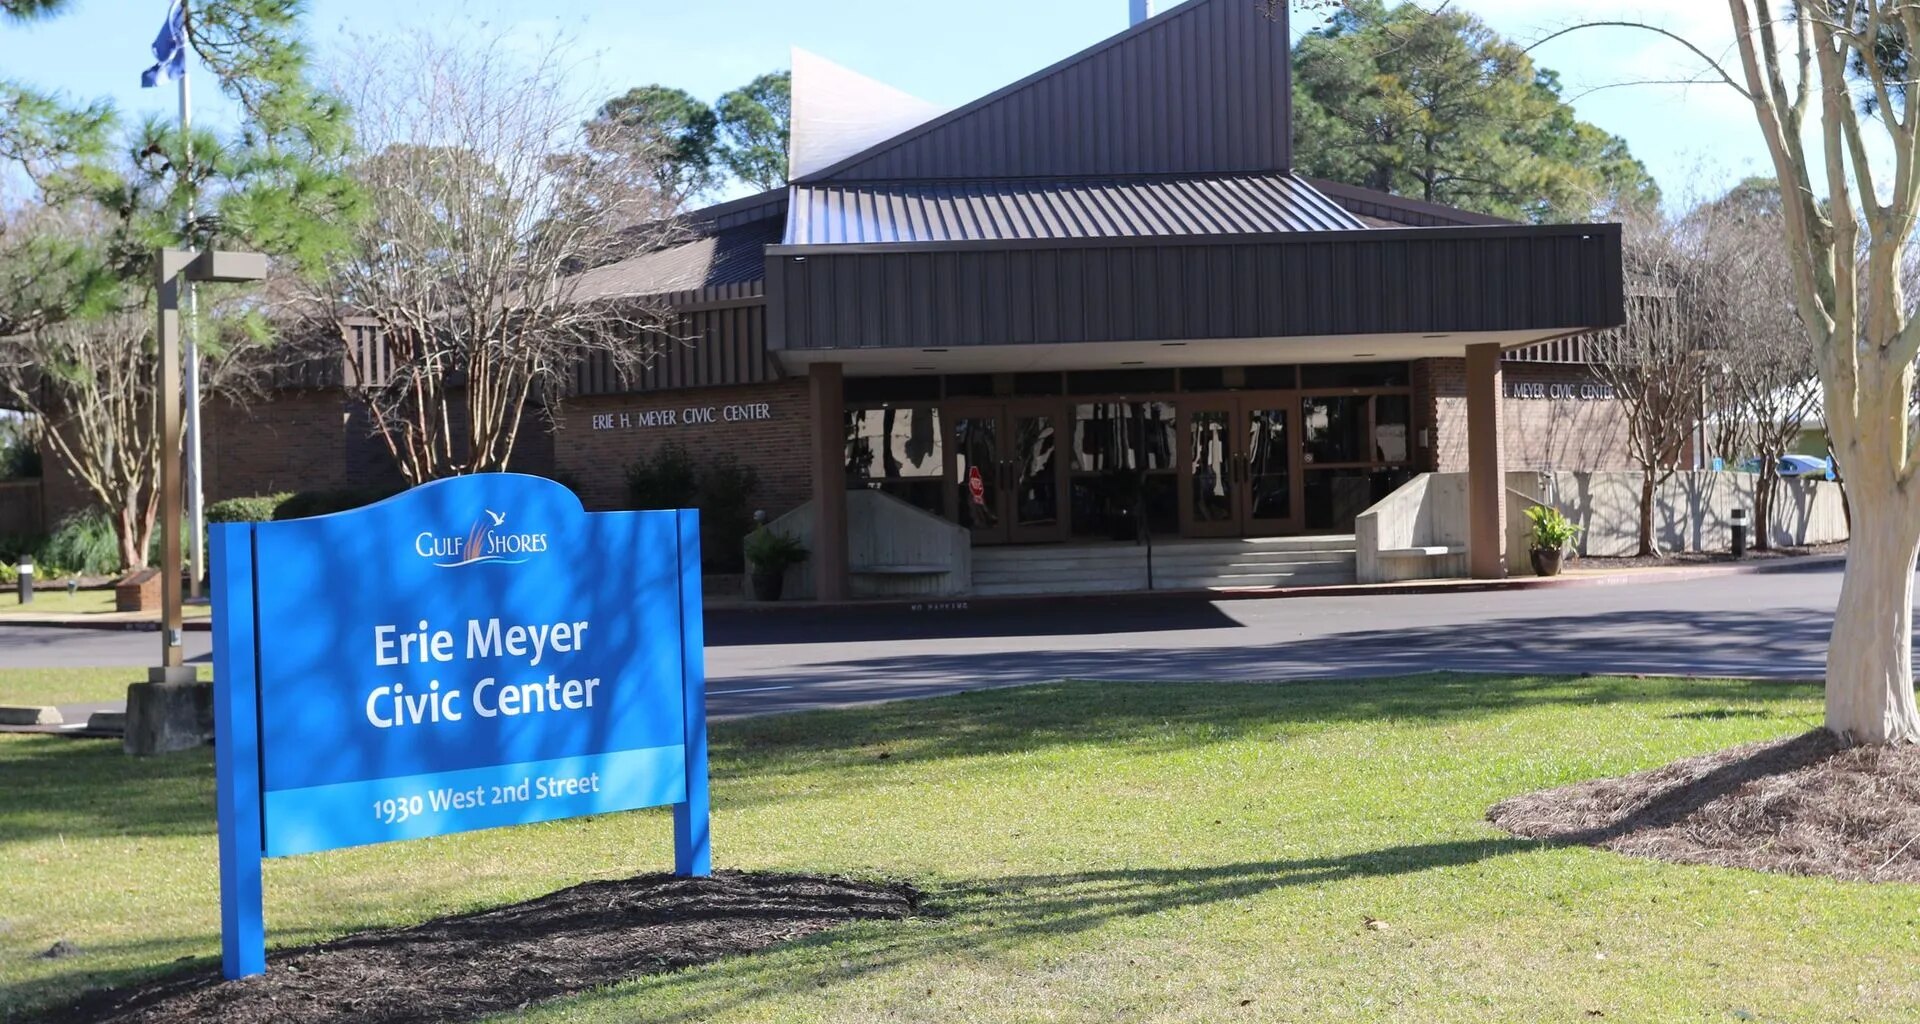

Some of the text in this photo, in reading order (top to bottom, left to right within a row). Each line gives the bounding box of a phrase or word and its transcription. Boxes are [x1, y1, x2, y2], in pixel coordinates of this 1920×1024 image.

[1513, 383, 1545, 398] MEYER
[1550, 383, 1576, 399] CIVIC
[1580, 384, 1615, 400] CENTER
[592, 403, 771, 430] ERIE H. MEYER CIVIC CENTER
[415, 529, 547, 557] GULF SHORES
[374, 617, 589, 667] Erie Meyer
[366, 674, 600, 728] Civic Center
[373, 770, 600, 824] 1930 West 2nd Street
